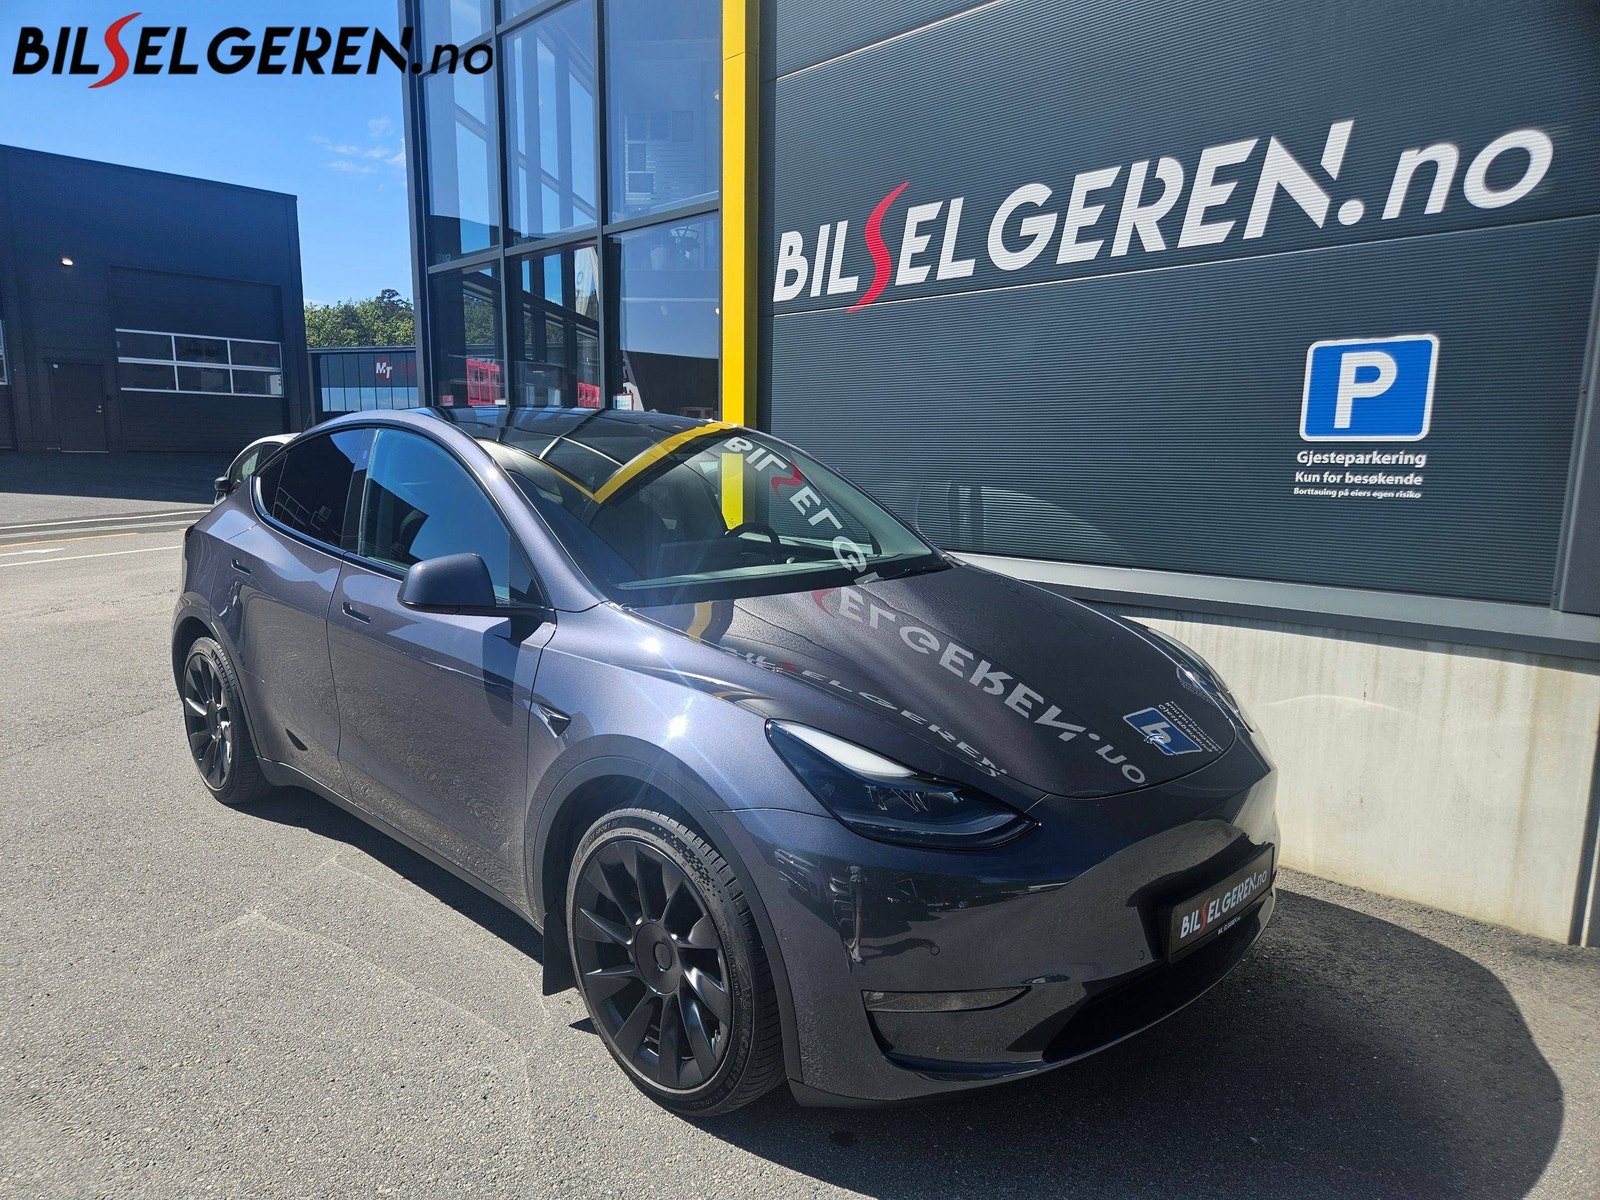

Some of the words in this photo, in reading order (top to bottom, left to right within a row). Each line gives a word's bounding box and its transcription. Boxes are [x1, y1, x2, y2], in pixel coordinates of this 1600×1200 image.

[774, 120, 1554, 313] BILSELGEREN.no
[1334, 351, 1398, 429] P
[1294, 471, 1320, 483] Kun
[1322, 471, 1343, 484] for
[1345, 472, 1423, 486] besøkende
[1296, 450, 1427, 468] Gjesteparkering
[1293, 487, 1337, 498] Borttauing
[1338, 488, 1350, 499] på
[1350, 488, 1371, 498] eiers
[1371, 489, 1395, 499] egen
[1395, 489, 1422, 499] risiko
[1179, 870, 1268, 939] BILSELGEREN.no
